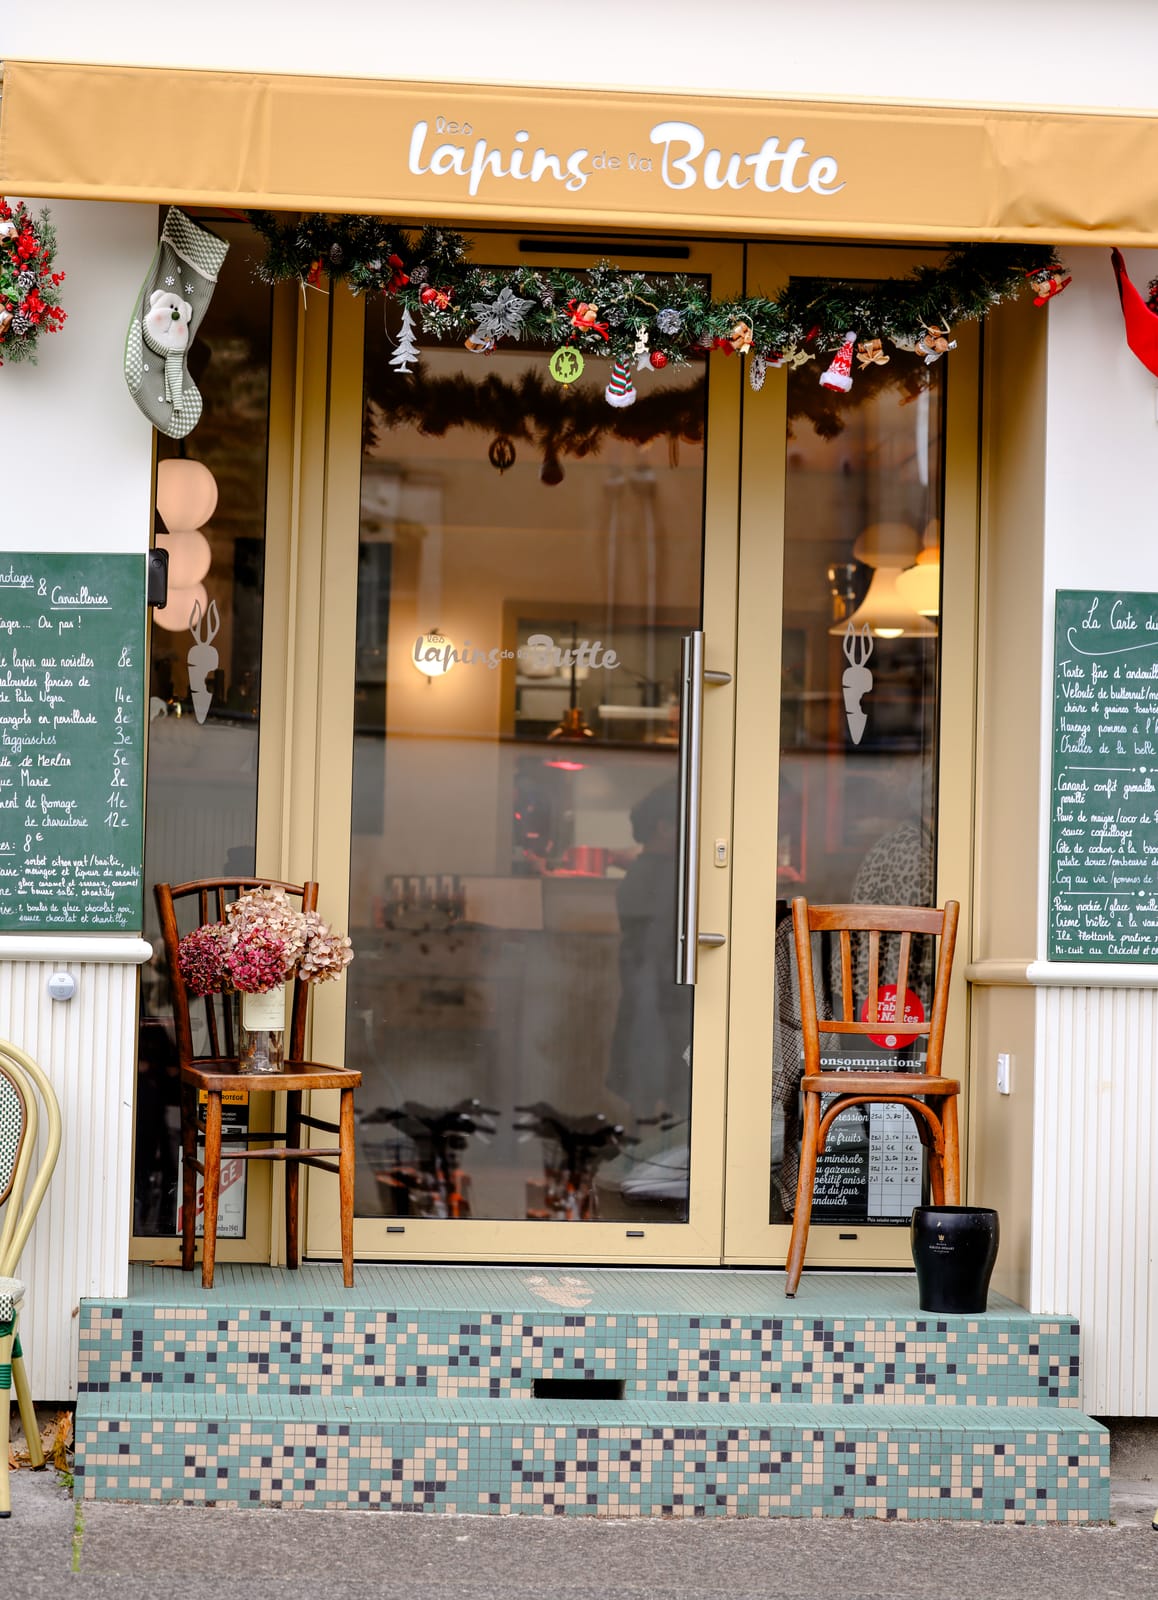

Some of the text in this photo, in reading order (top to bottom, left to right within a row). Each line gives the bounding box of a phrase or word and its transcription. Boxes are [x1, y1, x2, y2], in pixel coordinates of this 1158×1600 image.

[435, 116, 474, 136] les
[591, 150, 621, 171] de
[627, 153, 654, 173] la
[649, 120, 848, 195] Butte
[37, 577, 47, 596] &
[51, 586, 109, 604] Canailleries
[1082, 597, 1158, 630] La Carte du
[38, 615, 54, 628] Ou
[427, 632, 445, 644] les
[500, 650, 515, 660] de
[528, 634, 621, 669] Butte
[13, 647, 37, 673] lapin
[41, 657, 57, 667] aux
[60, 652, 94, 667] noisettes
[1059, 660, 1085, 677] Tarte
[1091, 662, 1109, 685] fine
[0, 670, 91, 692] alourdes farcies de
[1061, 681, 1109, 699] Velouté de
[16, 688, 33, 702] Pata
[39, 690, 66, 709] Negra
[1091, 701, 1099, 712] et
[1104, 704, 1129, 719] graines
[38, 714, 51, 724] en
[53, 709, 98, 729] persillade
[1060, 716, 1091, 738] Harengs
[1098, 724, 1128, 737] pommes
[2, 728, 57, 752] taggiasches
[1099, 742, 1110, 754] de
[1116, 740, 1127, 754] la
[1134, 741, 1157, 754] belle
[18, 755, 32, 767] de
[21, 768, 51, 787] Marie
[1057, 773, 1089, 791] Canard
[1094, 778, 1118, 799] confit
[25, 795, 37, 808] de
[41, 795, 78, 814] fromage
[25, 815, 38, 827] de
[42, 812, 89, 827] charcuterie
[1056, 806, 1074, 822] Pavé
[1077, 810, 1088, 822] de
[1139, 813, 1151, 823] de
[1061, 824, 1133, 846] sauce coquillages
[1056, 838, 1071, 853] Côte
[1074, 843, 1084, 853] de
[1088, 841, 1116, 854] cochon
[1127, 840, 1137, 853] la
[24, 854, 47, 866] sorbet
[52, 855, 71, 867] citron
[1057, 855, 1080, 868] patate
[61, 866, 70, 876] et
[75, 866, 101, 879] liqueur
[103, 867, 114, 876] de
[1056, 868, 1071, 891] Coq
[1075, 875, 1088, 884] au
[1093, 874, 1108, 884] vin
[1143, 874, 1153, 884] de
[18, 877, 34, 890] glace
[39, 877, 66, 887] caramel
[68, 879, 75, 887] et
[112, 879, 138, 887] caramel
[81, 887, 115, 900] chantilly
[27, 902, 48, 912] boules
[50, 903, 59, 912] de
[62, 902, 81, 915] glace
[85, 901, 115, 913] chocolat
[1053, 896, 1073, 911] Poire
[19, 912, 128, 927] sauce chocolat et chantilly
[1056, 912, 1080, 927] Crème
[1085, 914, 1111, 927] brûlée
[1128, 912, 1138, 927] la
[1108, 944, 1139, 955] Chocolat
[1142, 945, 1150, 955] et
[820, 1056, 922, 1067] onsommations
[838, 1112, 869, 1122] ression
[837, 1132, 863, 1145] fruits
[824, 1153, 864, 1164] minérale
[824, 1165, 861, 1178] gazeuse
[814, 1174, 841, 1188] péritif
[842, 1175, 867, 1185] anisé
[813, 1184, 860, 1199] lat du jour
[812, 1195, 849, 1205] andwich
